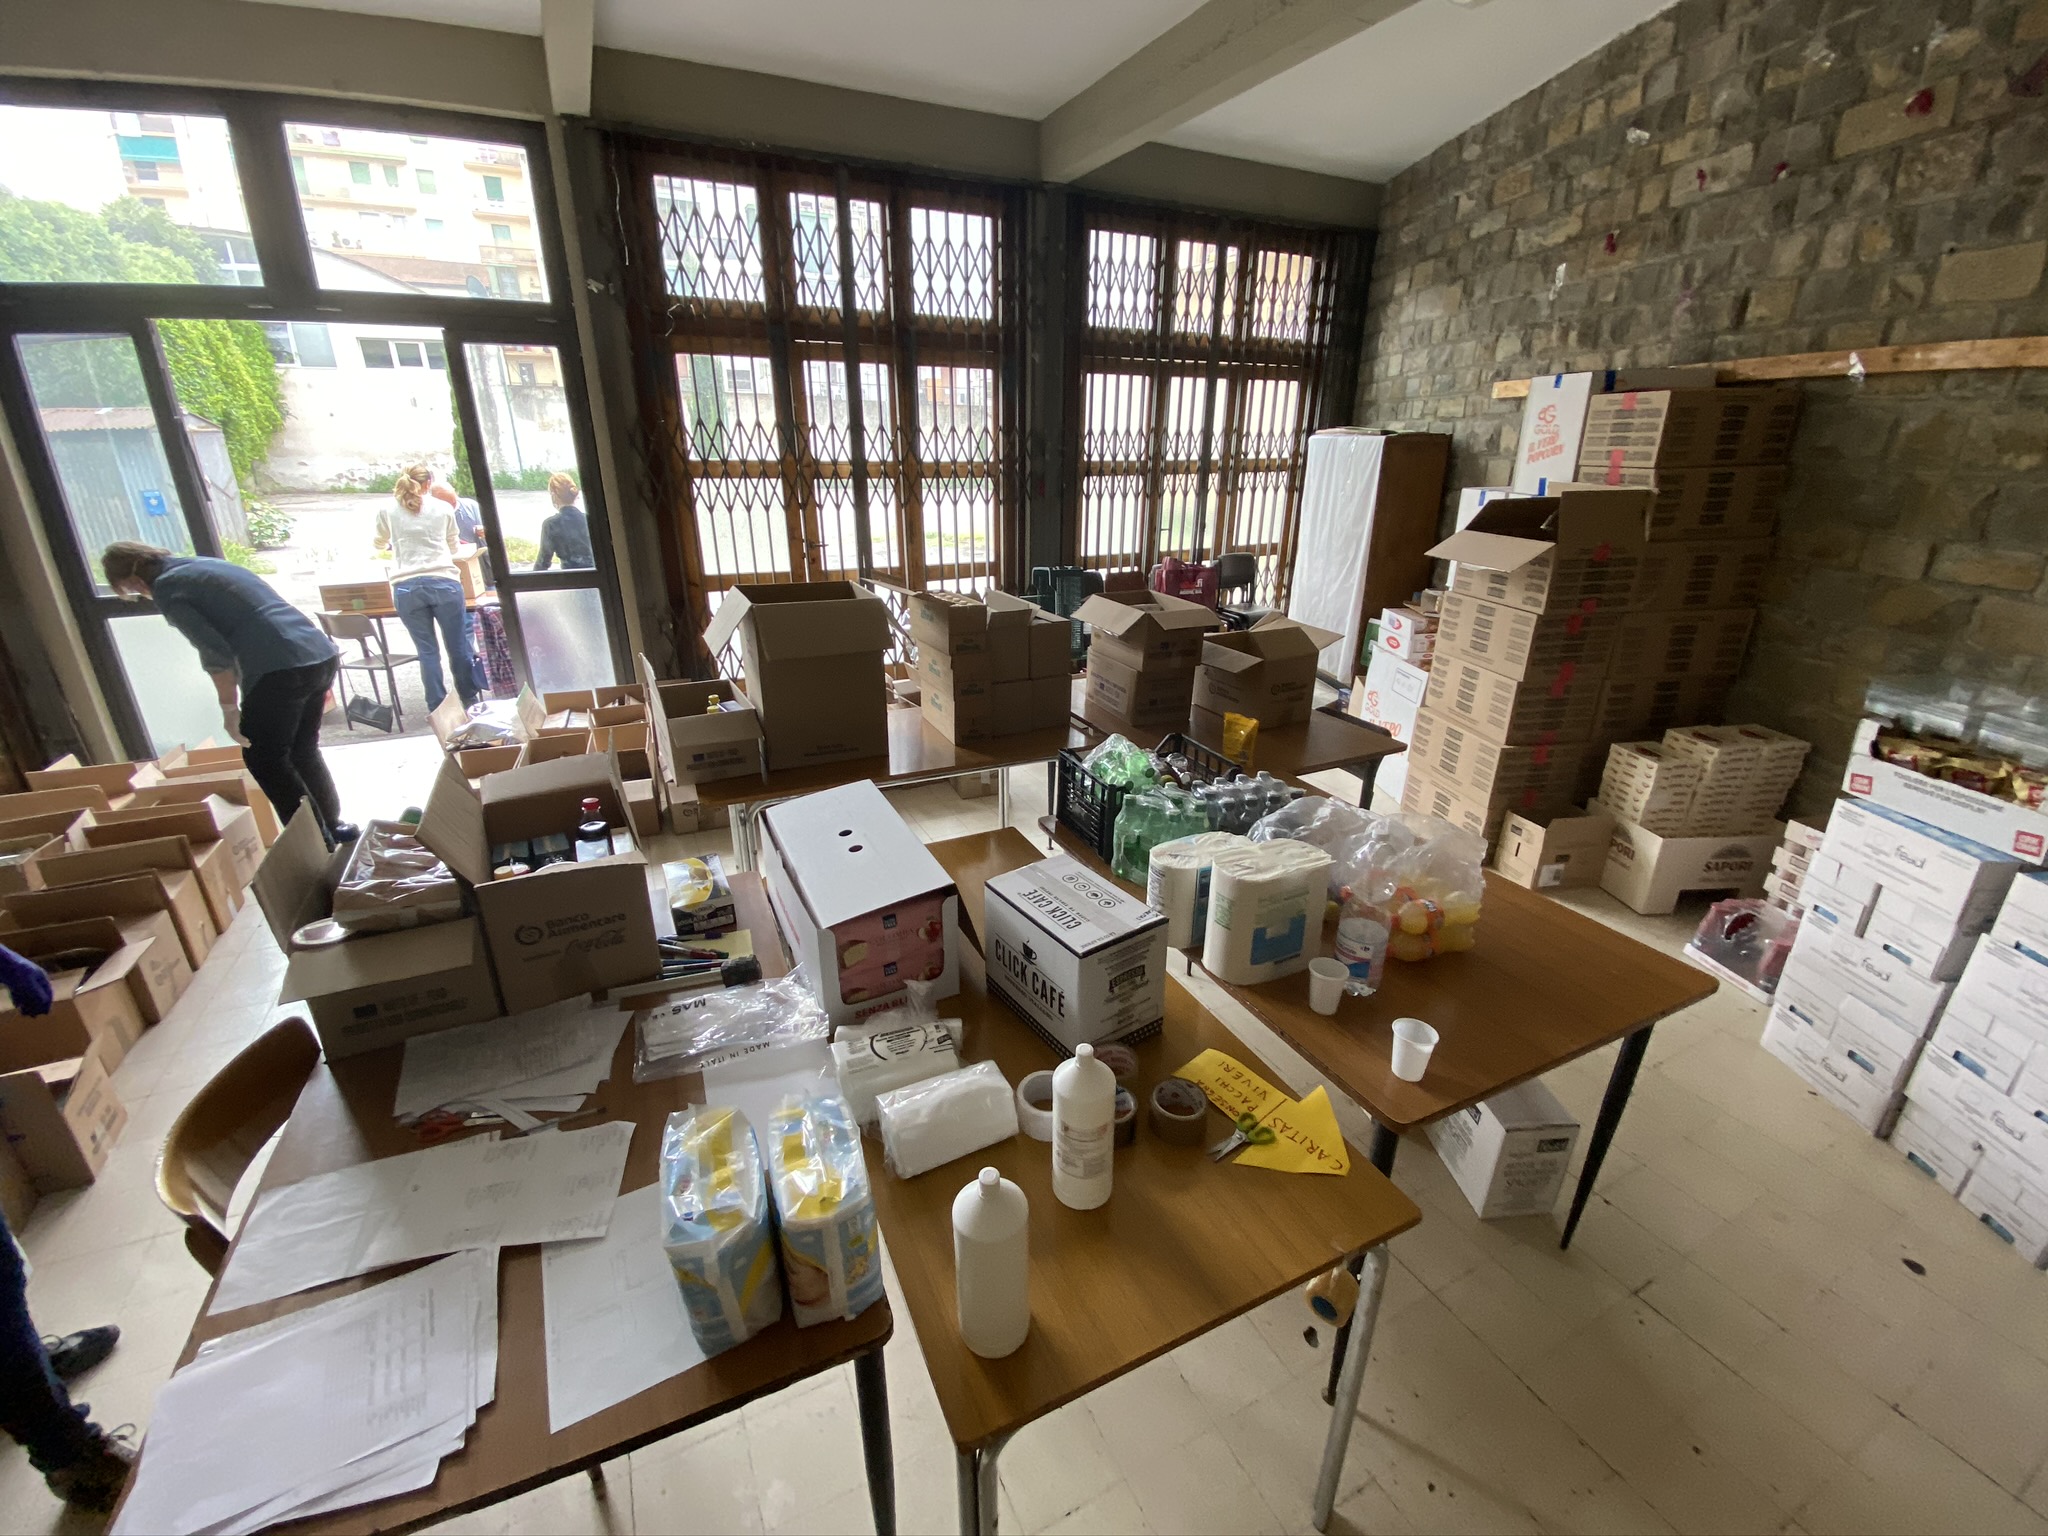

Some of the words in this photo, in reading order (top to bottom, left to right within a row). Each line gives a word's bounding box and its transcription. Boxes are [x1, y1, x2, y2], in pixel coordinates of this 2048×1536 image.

[545, 912, 590, 929] Banco
[549, 913, 627, 938] Alimentare
[1046, 906, 1083, 930] CLICK
[995, 938, 1029, 984] CLICK
[1031, 971, 1066, 1018] CAFÉ
[671, 998, 706, 1016] MAS
[855, 1000, 890, 1019] SENZA
[728, 1050, 739, 1059] IN
[743, 1041, 770, 1054] MADE
[699, 1055, 725, 1069] ITALY
[1218, 1060, 1268, 1100] VIVERI
[1195, 1079, 1240, 1117] ONSEGNA
[1214, 1077, 1258, 1113] PACCHI
[1267, 1116, 1344, 1171] CARITAS
